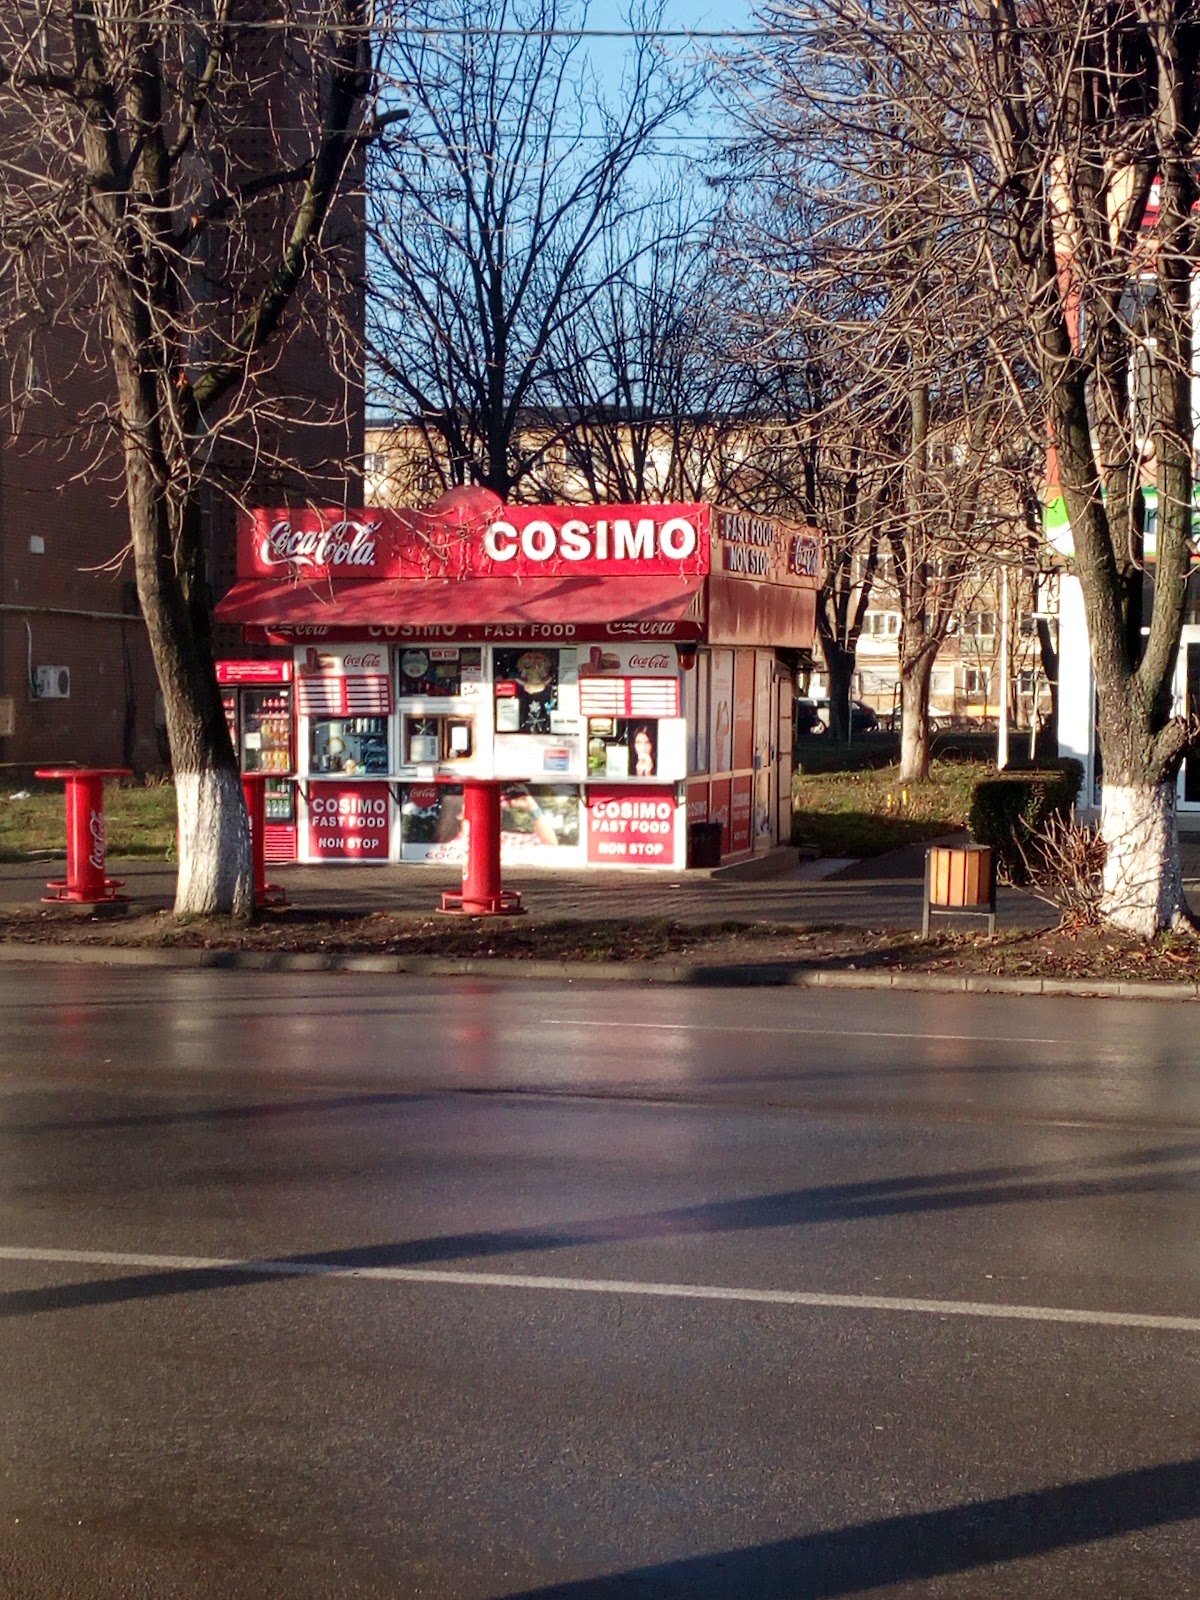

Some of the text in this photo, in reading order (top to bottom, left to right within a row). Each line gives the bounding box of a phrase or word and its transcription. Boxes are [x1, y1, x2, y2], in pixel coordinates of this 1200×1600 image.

[725, 513, 749, 543] FAST
[484, 518, 696, 562] COSIMO
[730, 544, 771, 576] NON STOP
[368, 623, 457, 637] COSIMO
[484, 623, 576, 637] FAST FOOD
[312, 798, 386, 815] COSIMO
[592, 802, 671, 820] COSIMO
[312, 815, 386, 828] FAST FOOD
[592, 820, 671, 834] FAST FOOD
[318, 837, 379, 849] NON STOP
[598, 842, 664, 855] NON STOP
